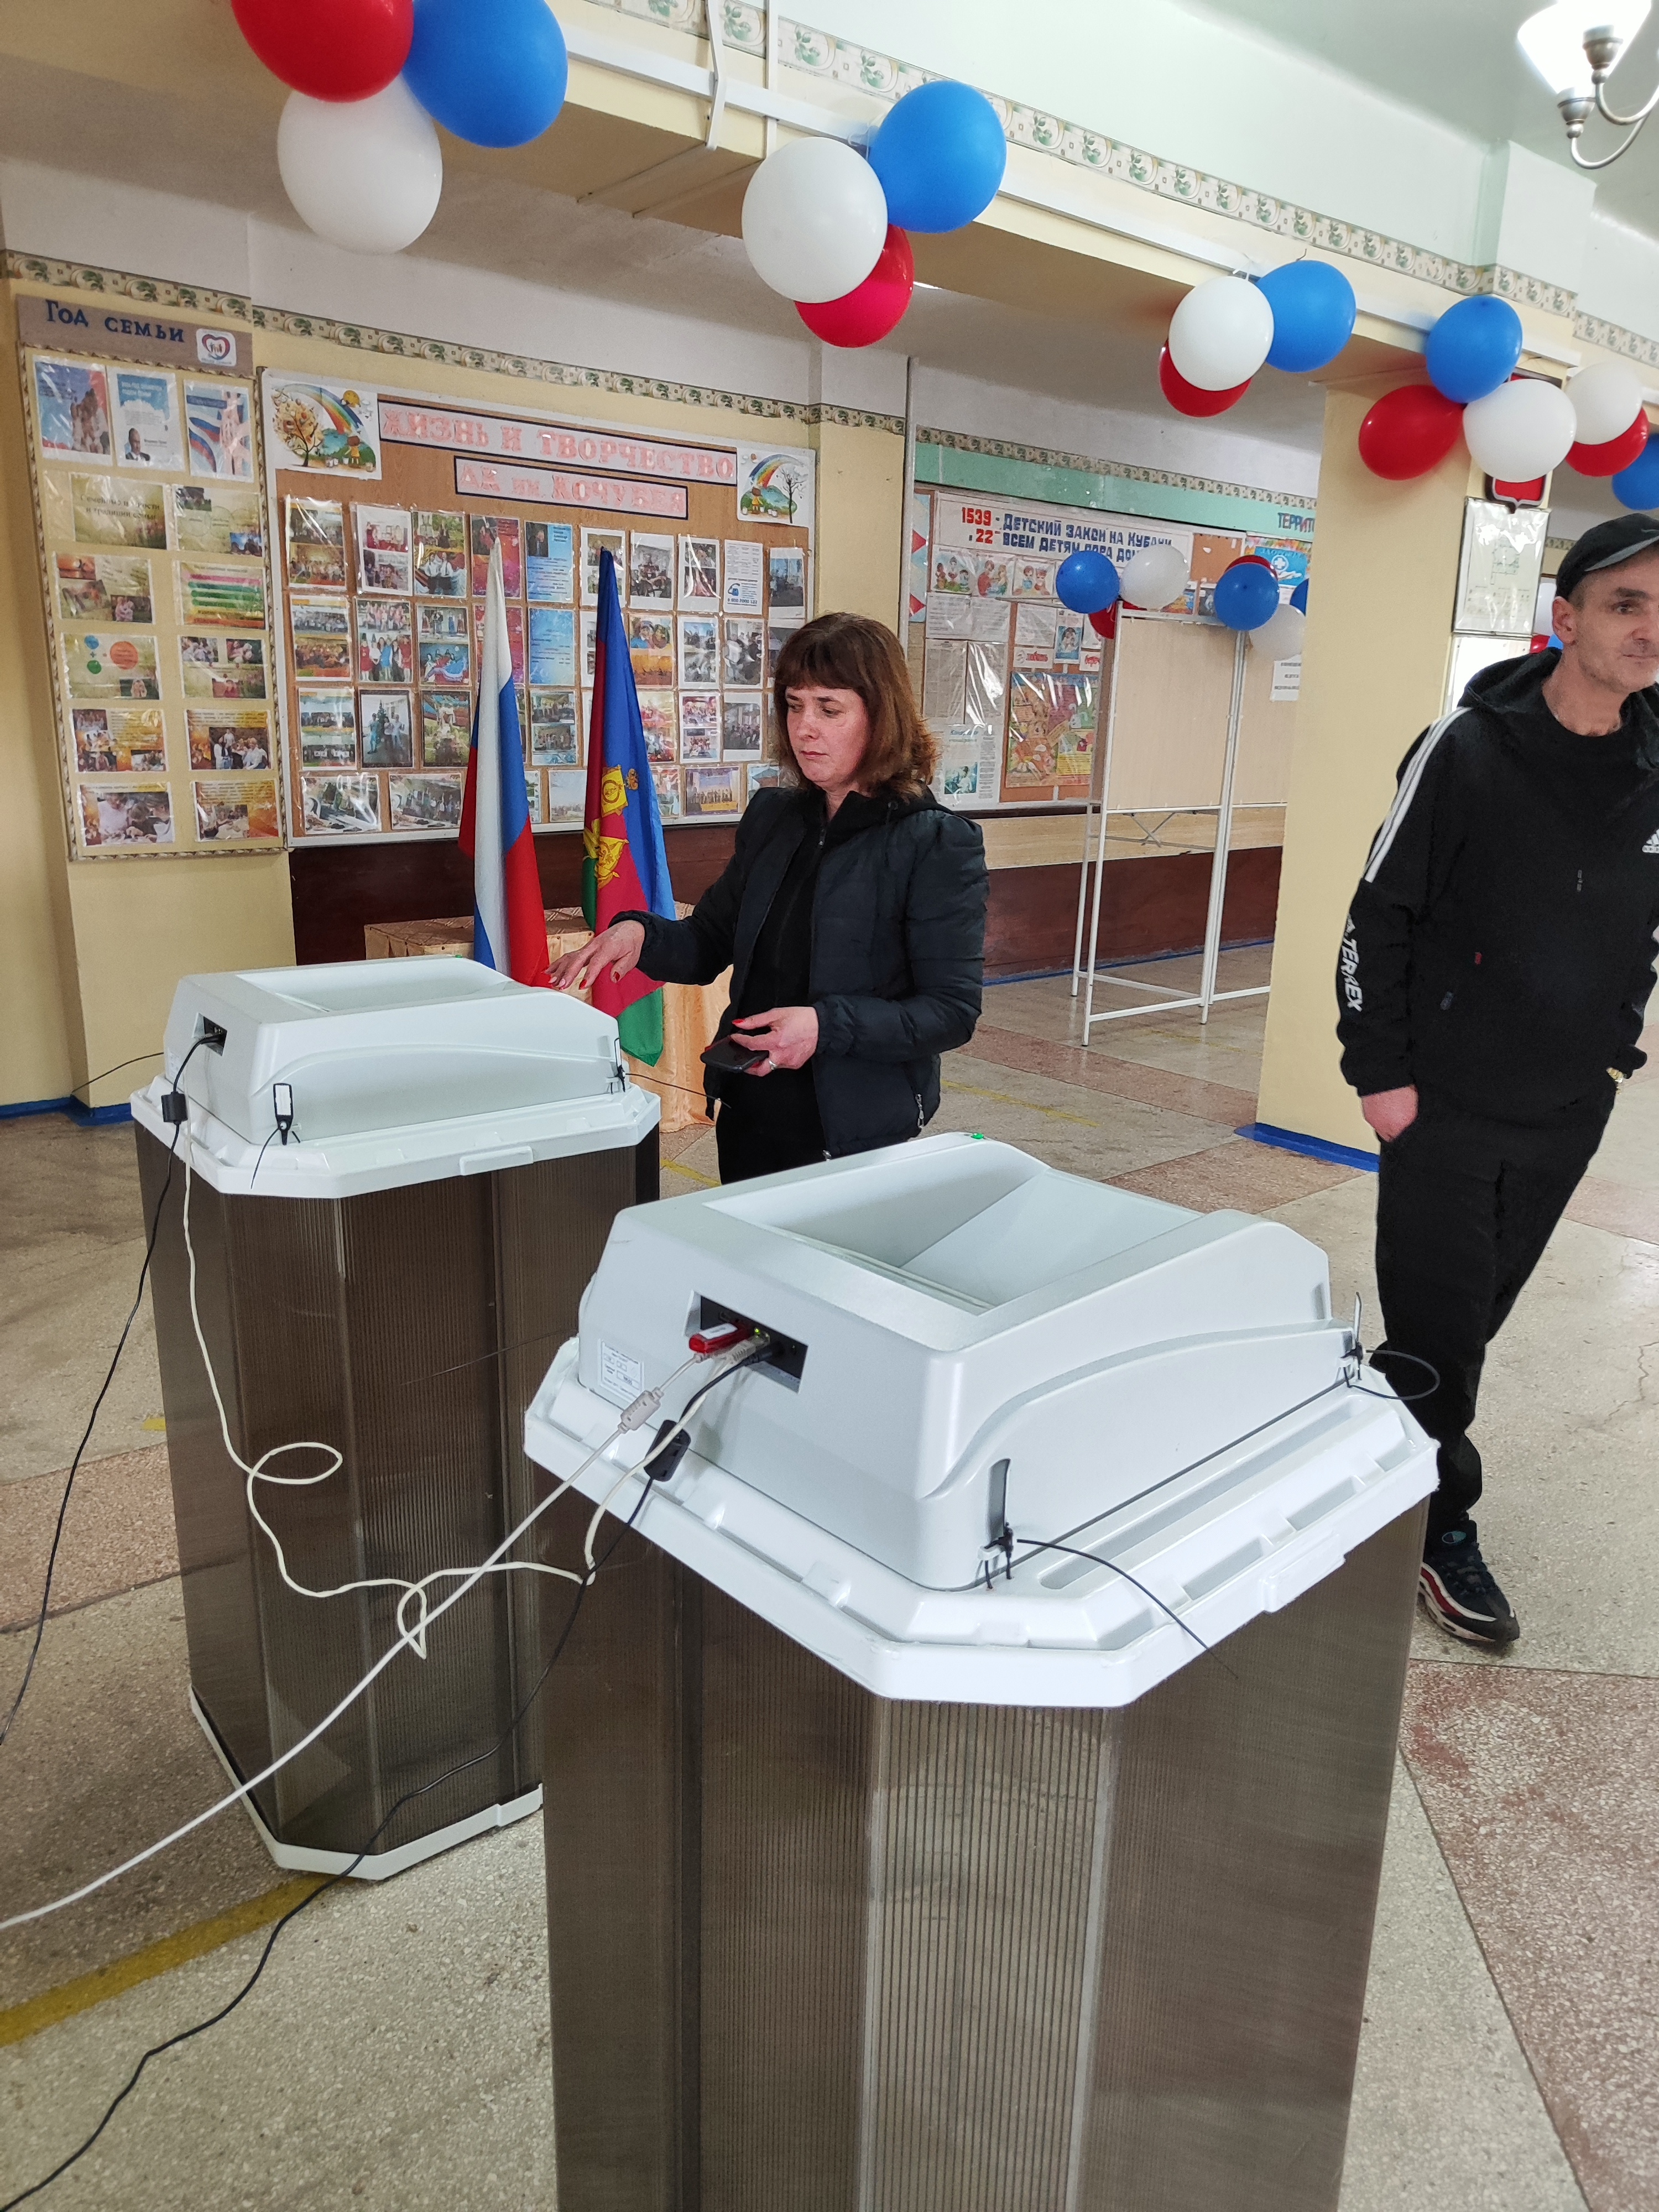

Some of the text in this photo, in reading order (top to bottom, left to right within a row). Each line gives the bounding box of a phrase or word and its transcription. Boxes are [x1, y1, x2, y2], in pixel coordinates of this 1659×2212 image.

[383, 409, 734, 481] ЖИЗНЬ И ТВОРЧЕСТВО
[962, 507, 992, 526] 1539
[1003, 513, 1061, 536] ДЕТСКИЙ
[1066, 524, 1105, 542] ЗАКОН
[1109, 531, 1124, 545] НА
[1277, 512, 1315, 532] ТЕРРИТ
[1003, 533, 1035, 549] ВСЕМ
[1039, 538, 1080, 555] ДЕТЯМ
[1340, 937, 1363, 1012] TERREX
